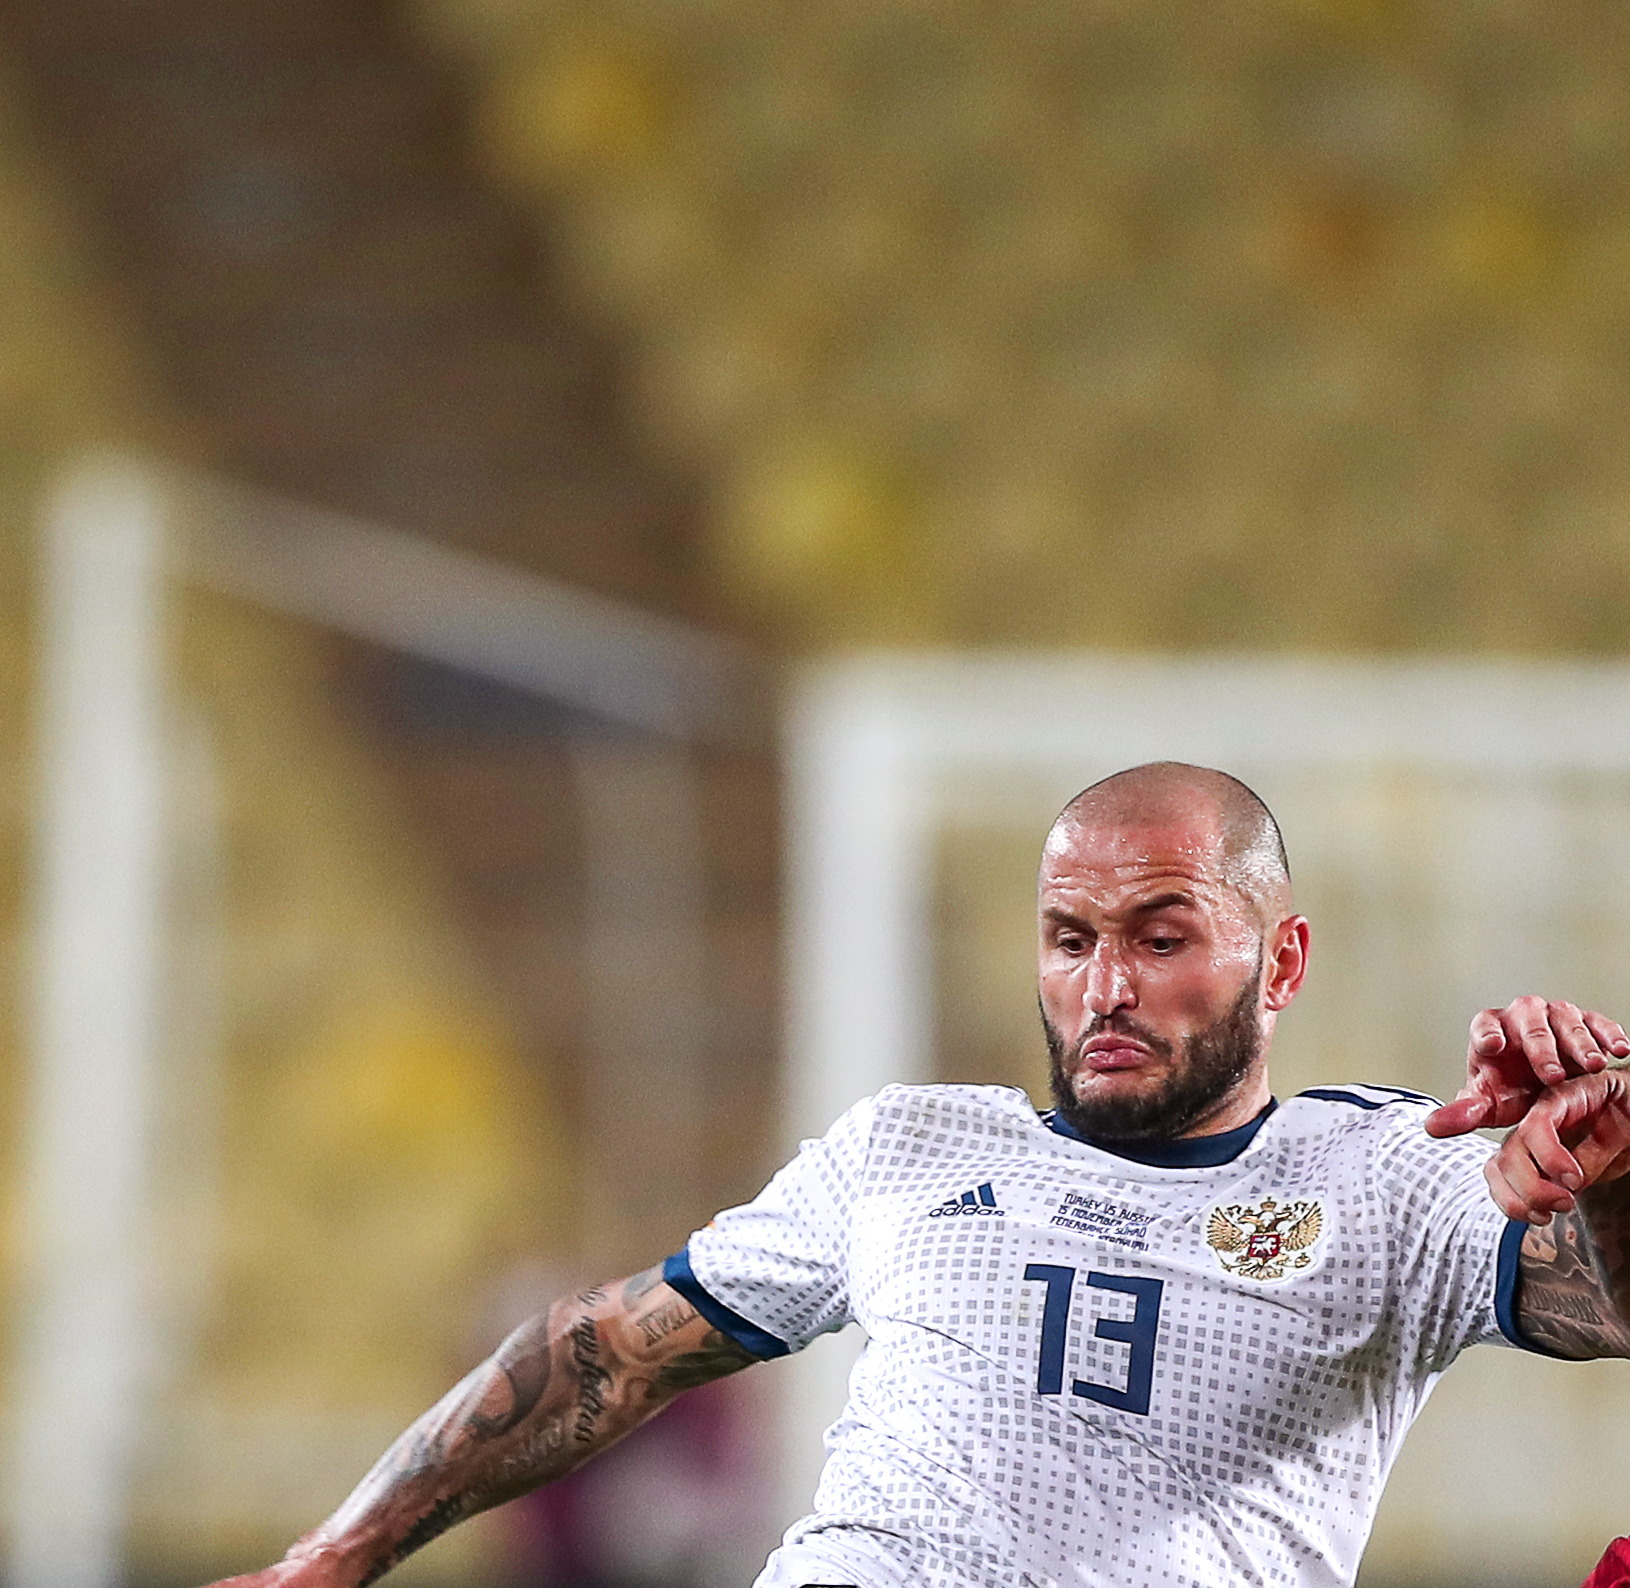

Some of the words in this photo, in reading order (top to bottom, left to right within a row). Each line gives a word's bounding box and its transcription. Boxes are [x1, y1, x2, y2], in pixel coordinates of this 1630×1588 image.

[1063, 1192, 1103, 1211] TURKEY
[1103, 1203, 1118, 1216] VS
[1023, 1263, 1164, 1416] 13
